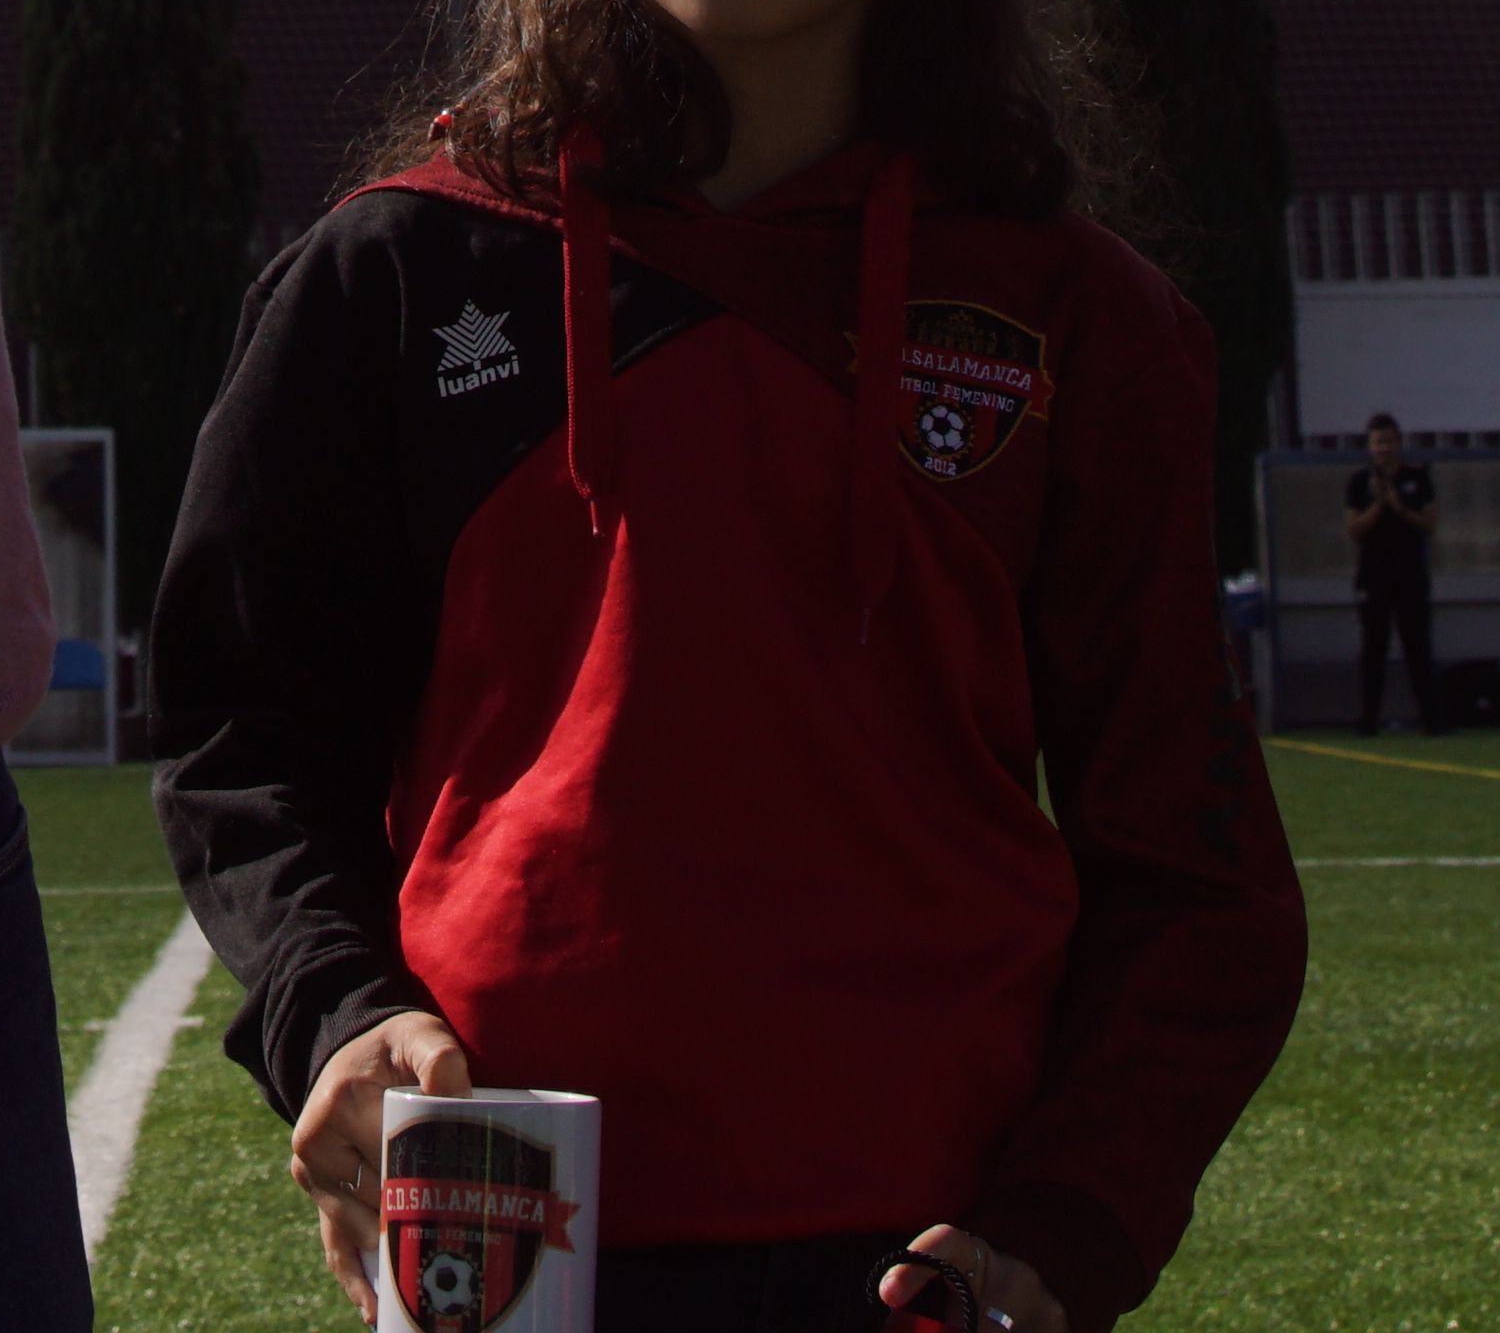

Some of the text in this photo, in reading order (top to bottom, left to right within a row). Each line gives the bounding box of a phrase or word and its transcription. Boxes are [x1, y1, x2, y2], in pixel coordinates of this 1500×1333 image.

[437, 354, 520, 397] luanvi
[942, 383, 1016, 413] FEMENINO
[923, 455, 958, 477] 2012
[386, 1187, 544, 1223] C.D.SALAMANCA
